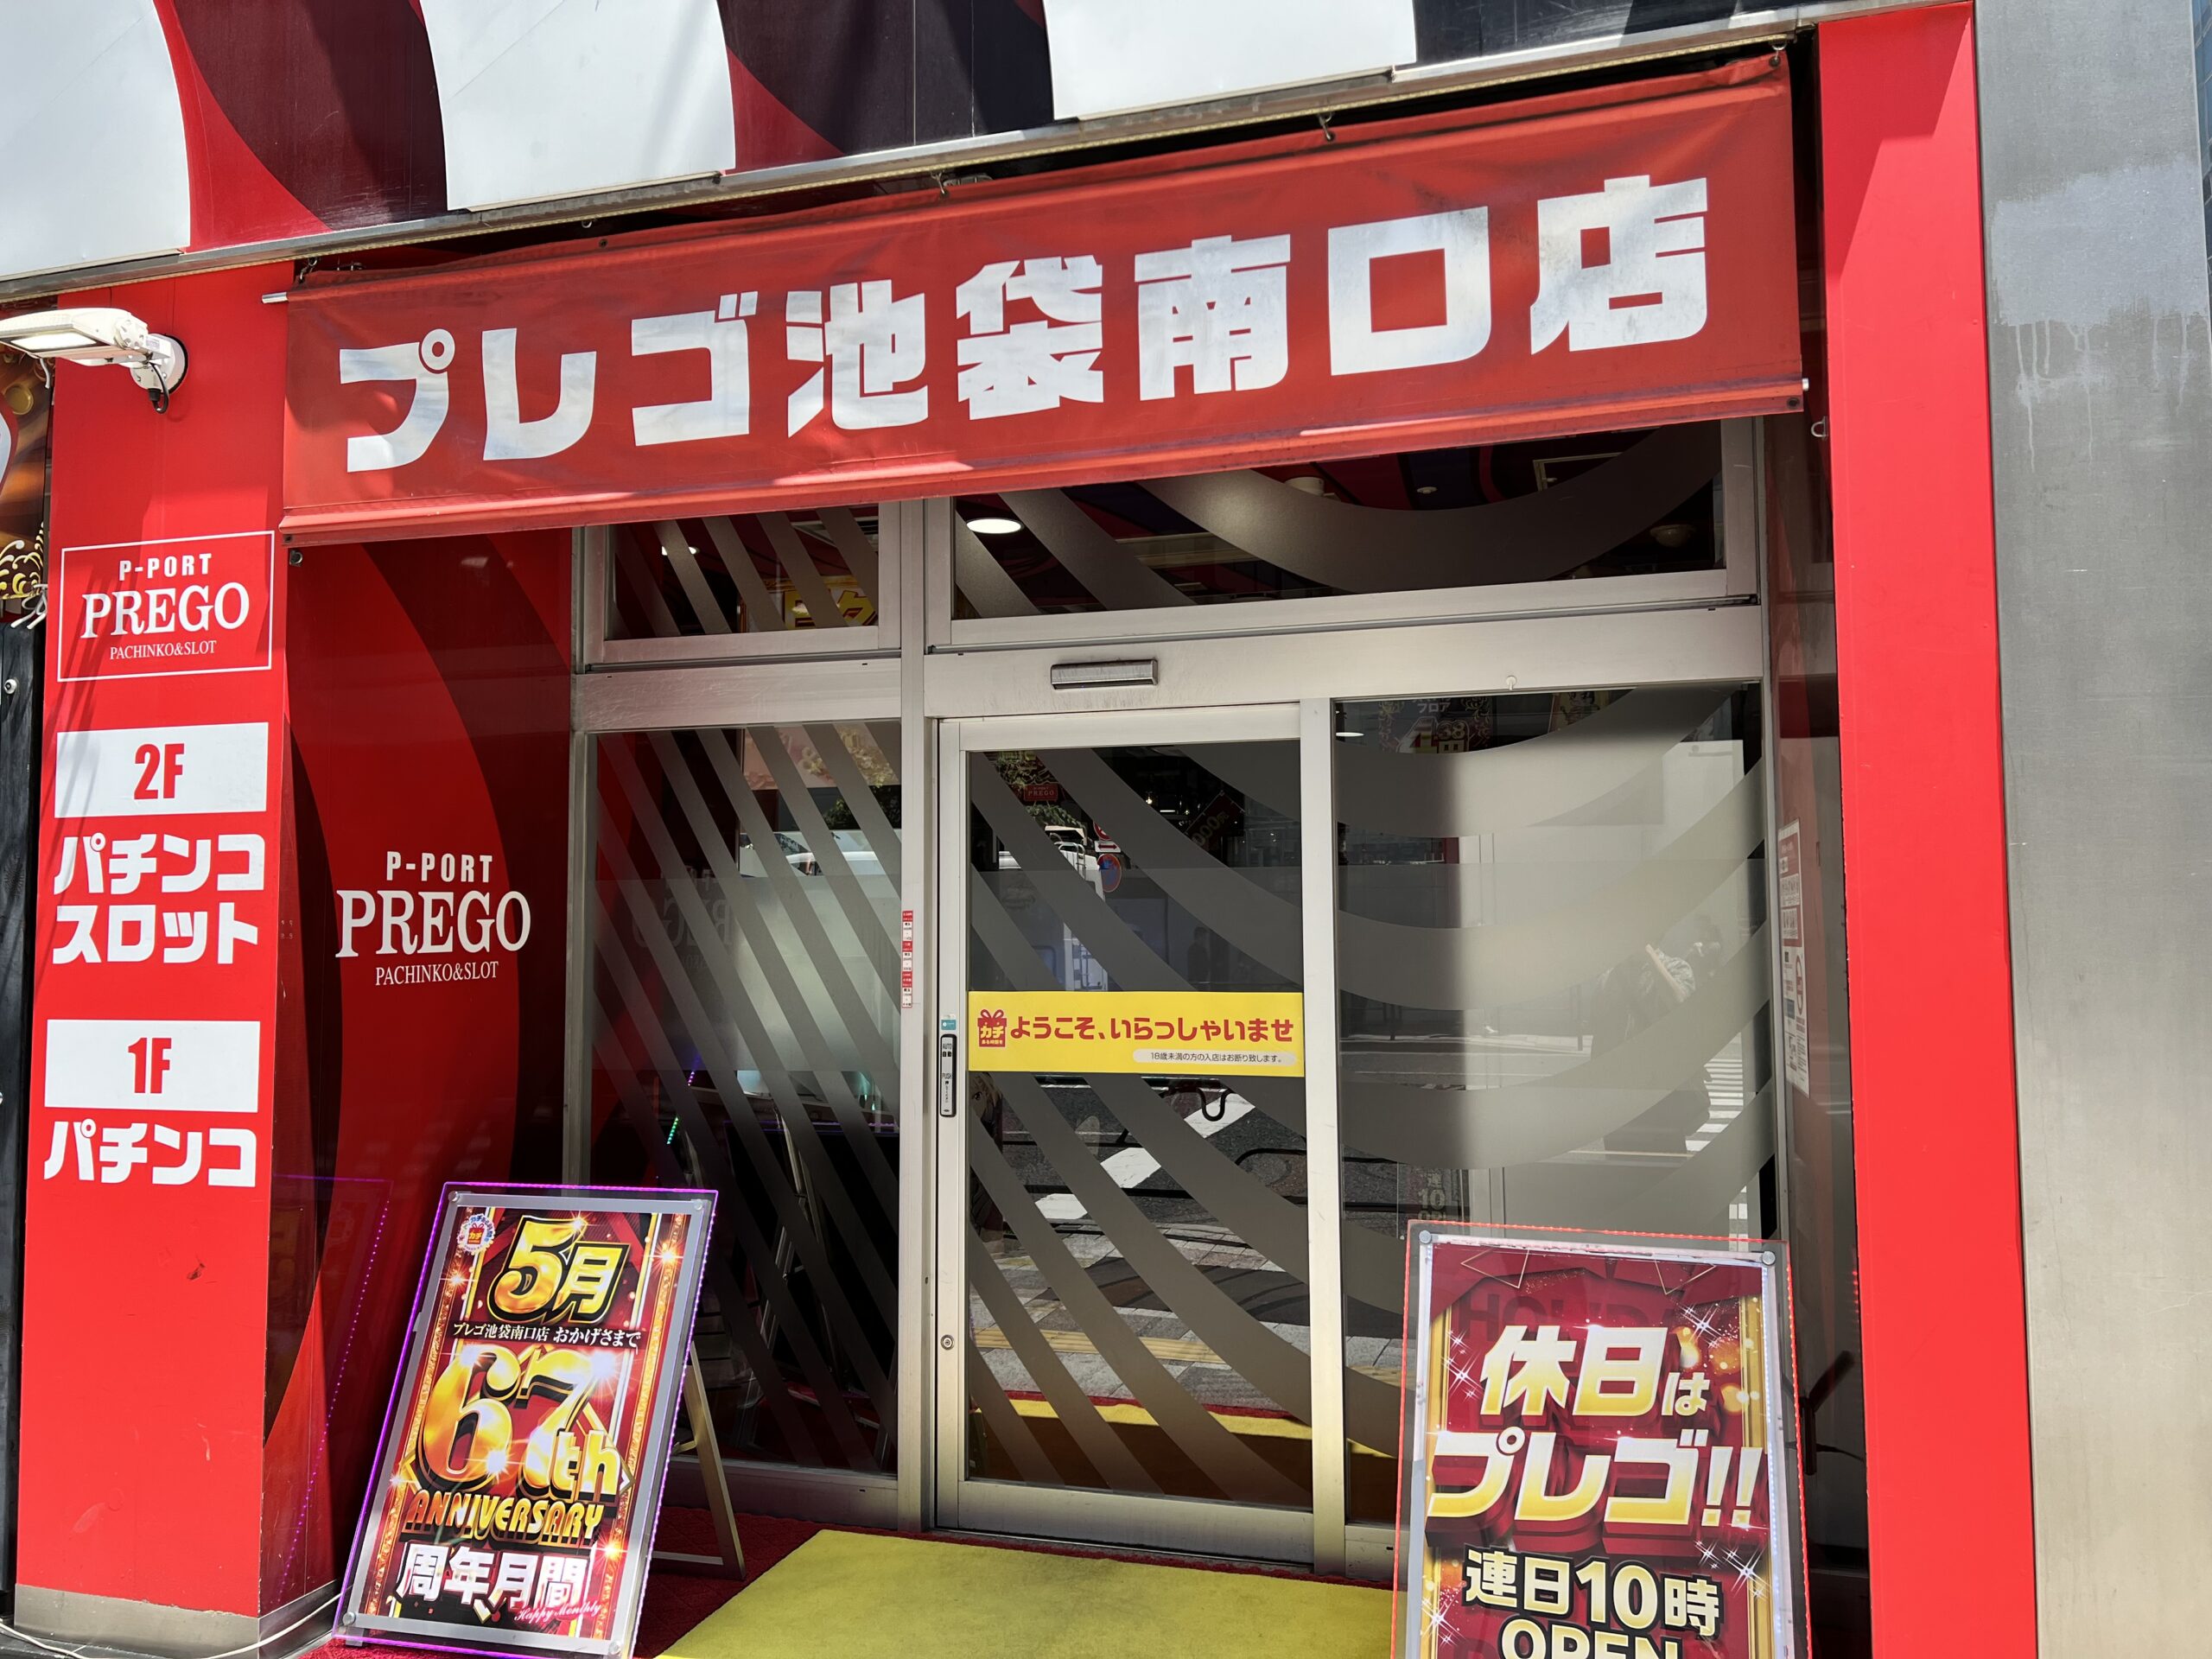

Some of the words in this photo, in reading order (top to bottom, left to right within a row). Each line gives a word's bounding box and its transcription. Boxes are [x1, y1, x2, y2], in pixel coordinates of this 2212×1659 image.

[339, 174, 1708, 473] プレゴ池袋南口店
[118, 552, 212, 582] P-PORT
[79, 582, 250, 639] PREGO
[110, 639, 217, 660] PACHINKO&SLOT
[133, 742, 185, 800] 2F
[52, 833, 266, 895] パチンコ
[386, 850, 493, 883] P-PORT
[52, 901, 259, 965] スロット
[335, 890, 531, 957] PREGO
[375, 960, 499, 986] PACHINKO&SLOT
[1010, 1015, 1294, 1043] ようこそ、いらっしゃいませ
[1150, 1052, 1282, 1063] 18歳未満の方の入店はお断り致します。
[127, 1037, 173, 1095] 1F
[43, 1118, 257, 1188] パチンコ
[490, 1217, 629, 1319] 5月
[454, 1323, 550, 1342] プレゴ池袋南口店
[553, 1326, 642, 1350] おかげさまで
[1479, 1325, 1711, 1417] 休日は
[422, 1342, 622, 1498] 67th
[404, 1489, 605, 1543] ANNIVERSARY
[396, 1541, 591, 1610] 周年月間
[1465, 1548, 1719, 1637] 連日10時
[513, 1606, 553, 1624] Happy
